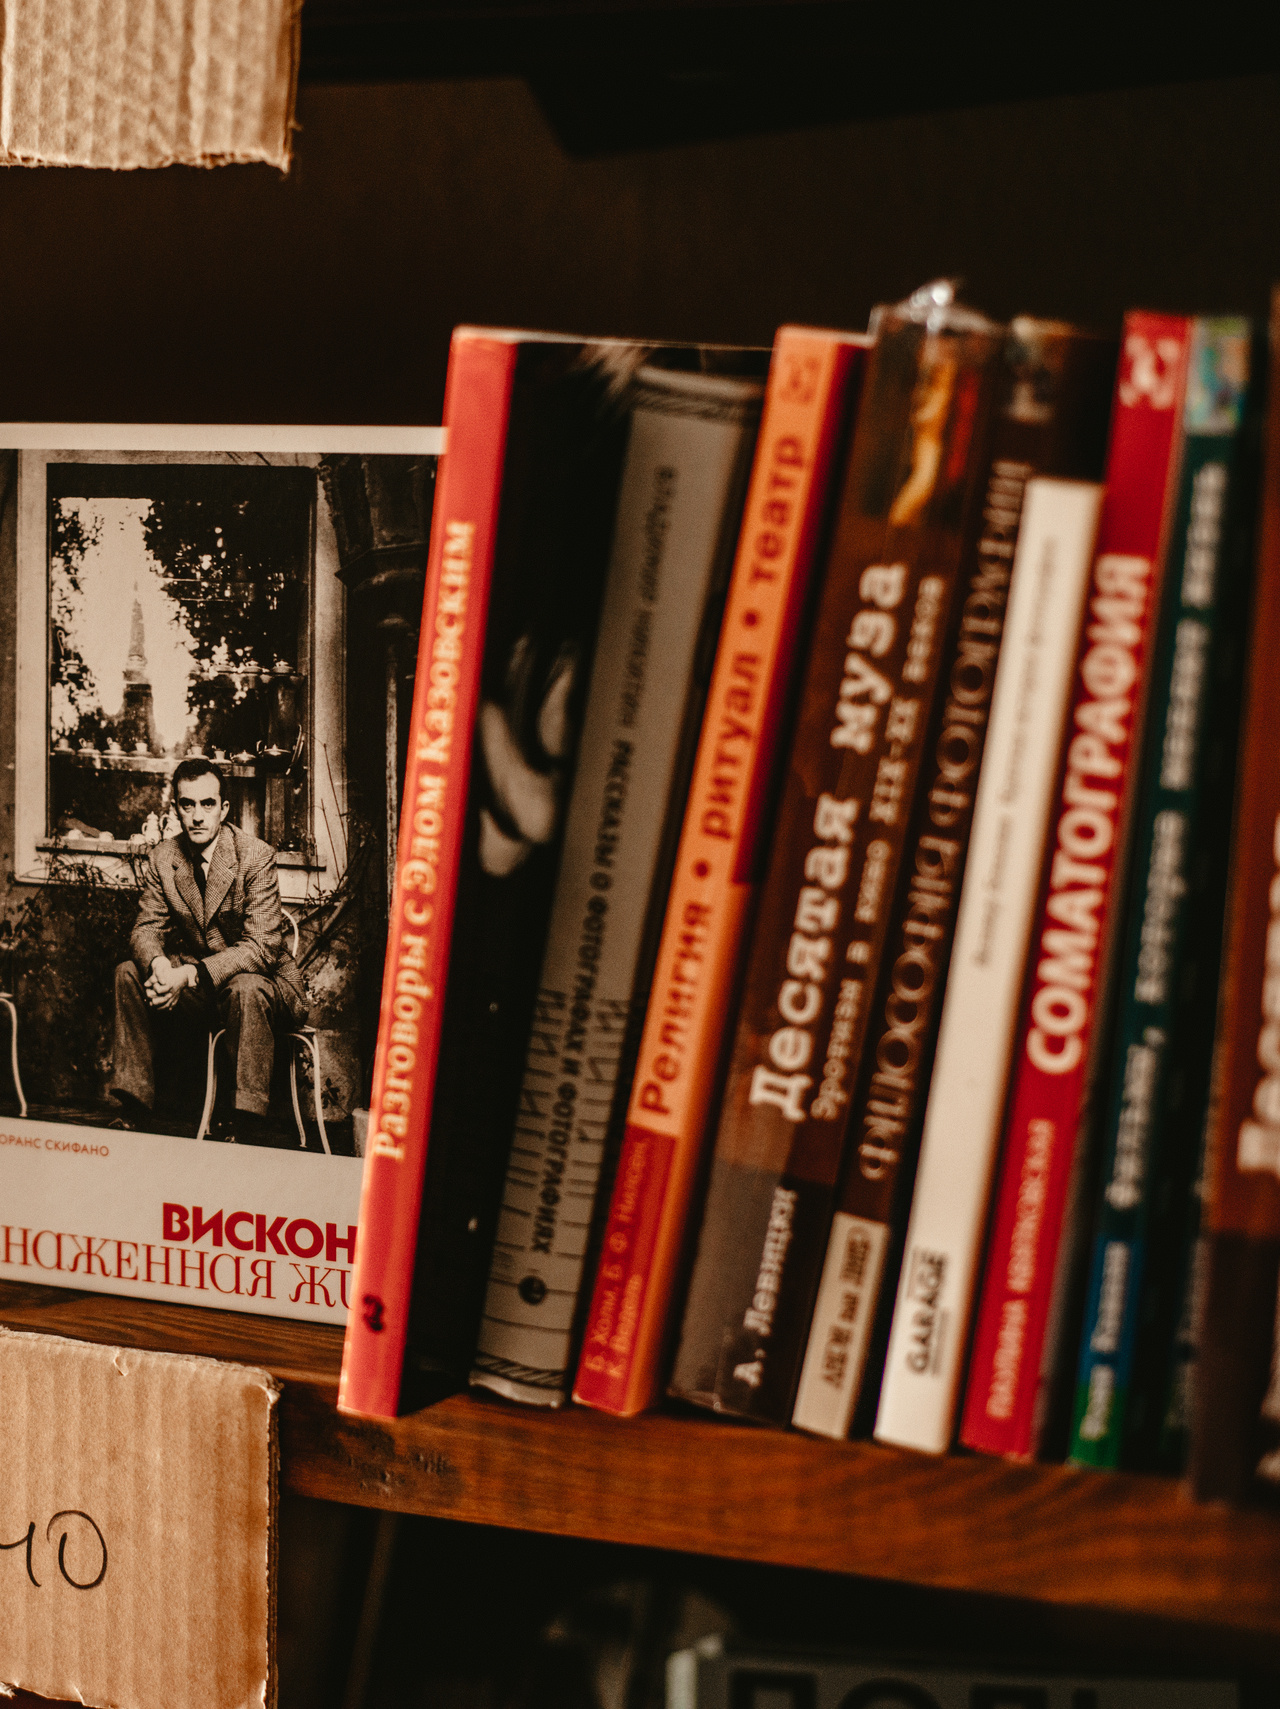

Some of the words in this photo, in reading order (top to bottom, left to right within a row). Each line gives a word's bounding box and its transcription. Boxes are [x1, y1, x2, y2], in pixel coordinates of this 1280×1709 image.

[415, 519, 476, 765] Казовским
[401, 774, 449, 896] Элом
[594, 738, 634, 870] РАССКАЗЫ
[638, 902, 712, 1116] Религия
[699, 652, 761, 842] ритуал
[748, 435, 807, 588] театр
[748, 790, 862, 1123] Десятая
[829, 559, 909, 756] муза
[1024, 552, 1153, 1076] СОМАТОГРАФИЯ
[372, 932, 434, 1162] Разговоры
[564, 894, 609, 1054] ФОТОГРАФАХ
[809, 978, 864, 1121] Эротизм
[857, 835, 961, 1182] ФИЛОСОФИЯ
[44, 1137, 111, 1158] СКИФАНО
[531, 1081, 578, 1254] ФОТОГРАФИЯХ
[732, 1348, 767, 1389] А.
[904, 1251, 949, 1375] GARAGE
